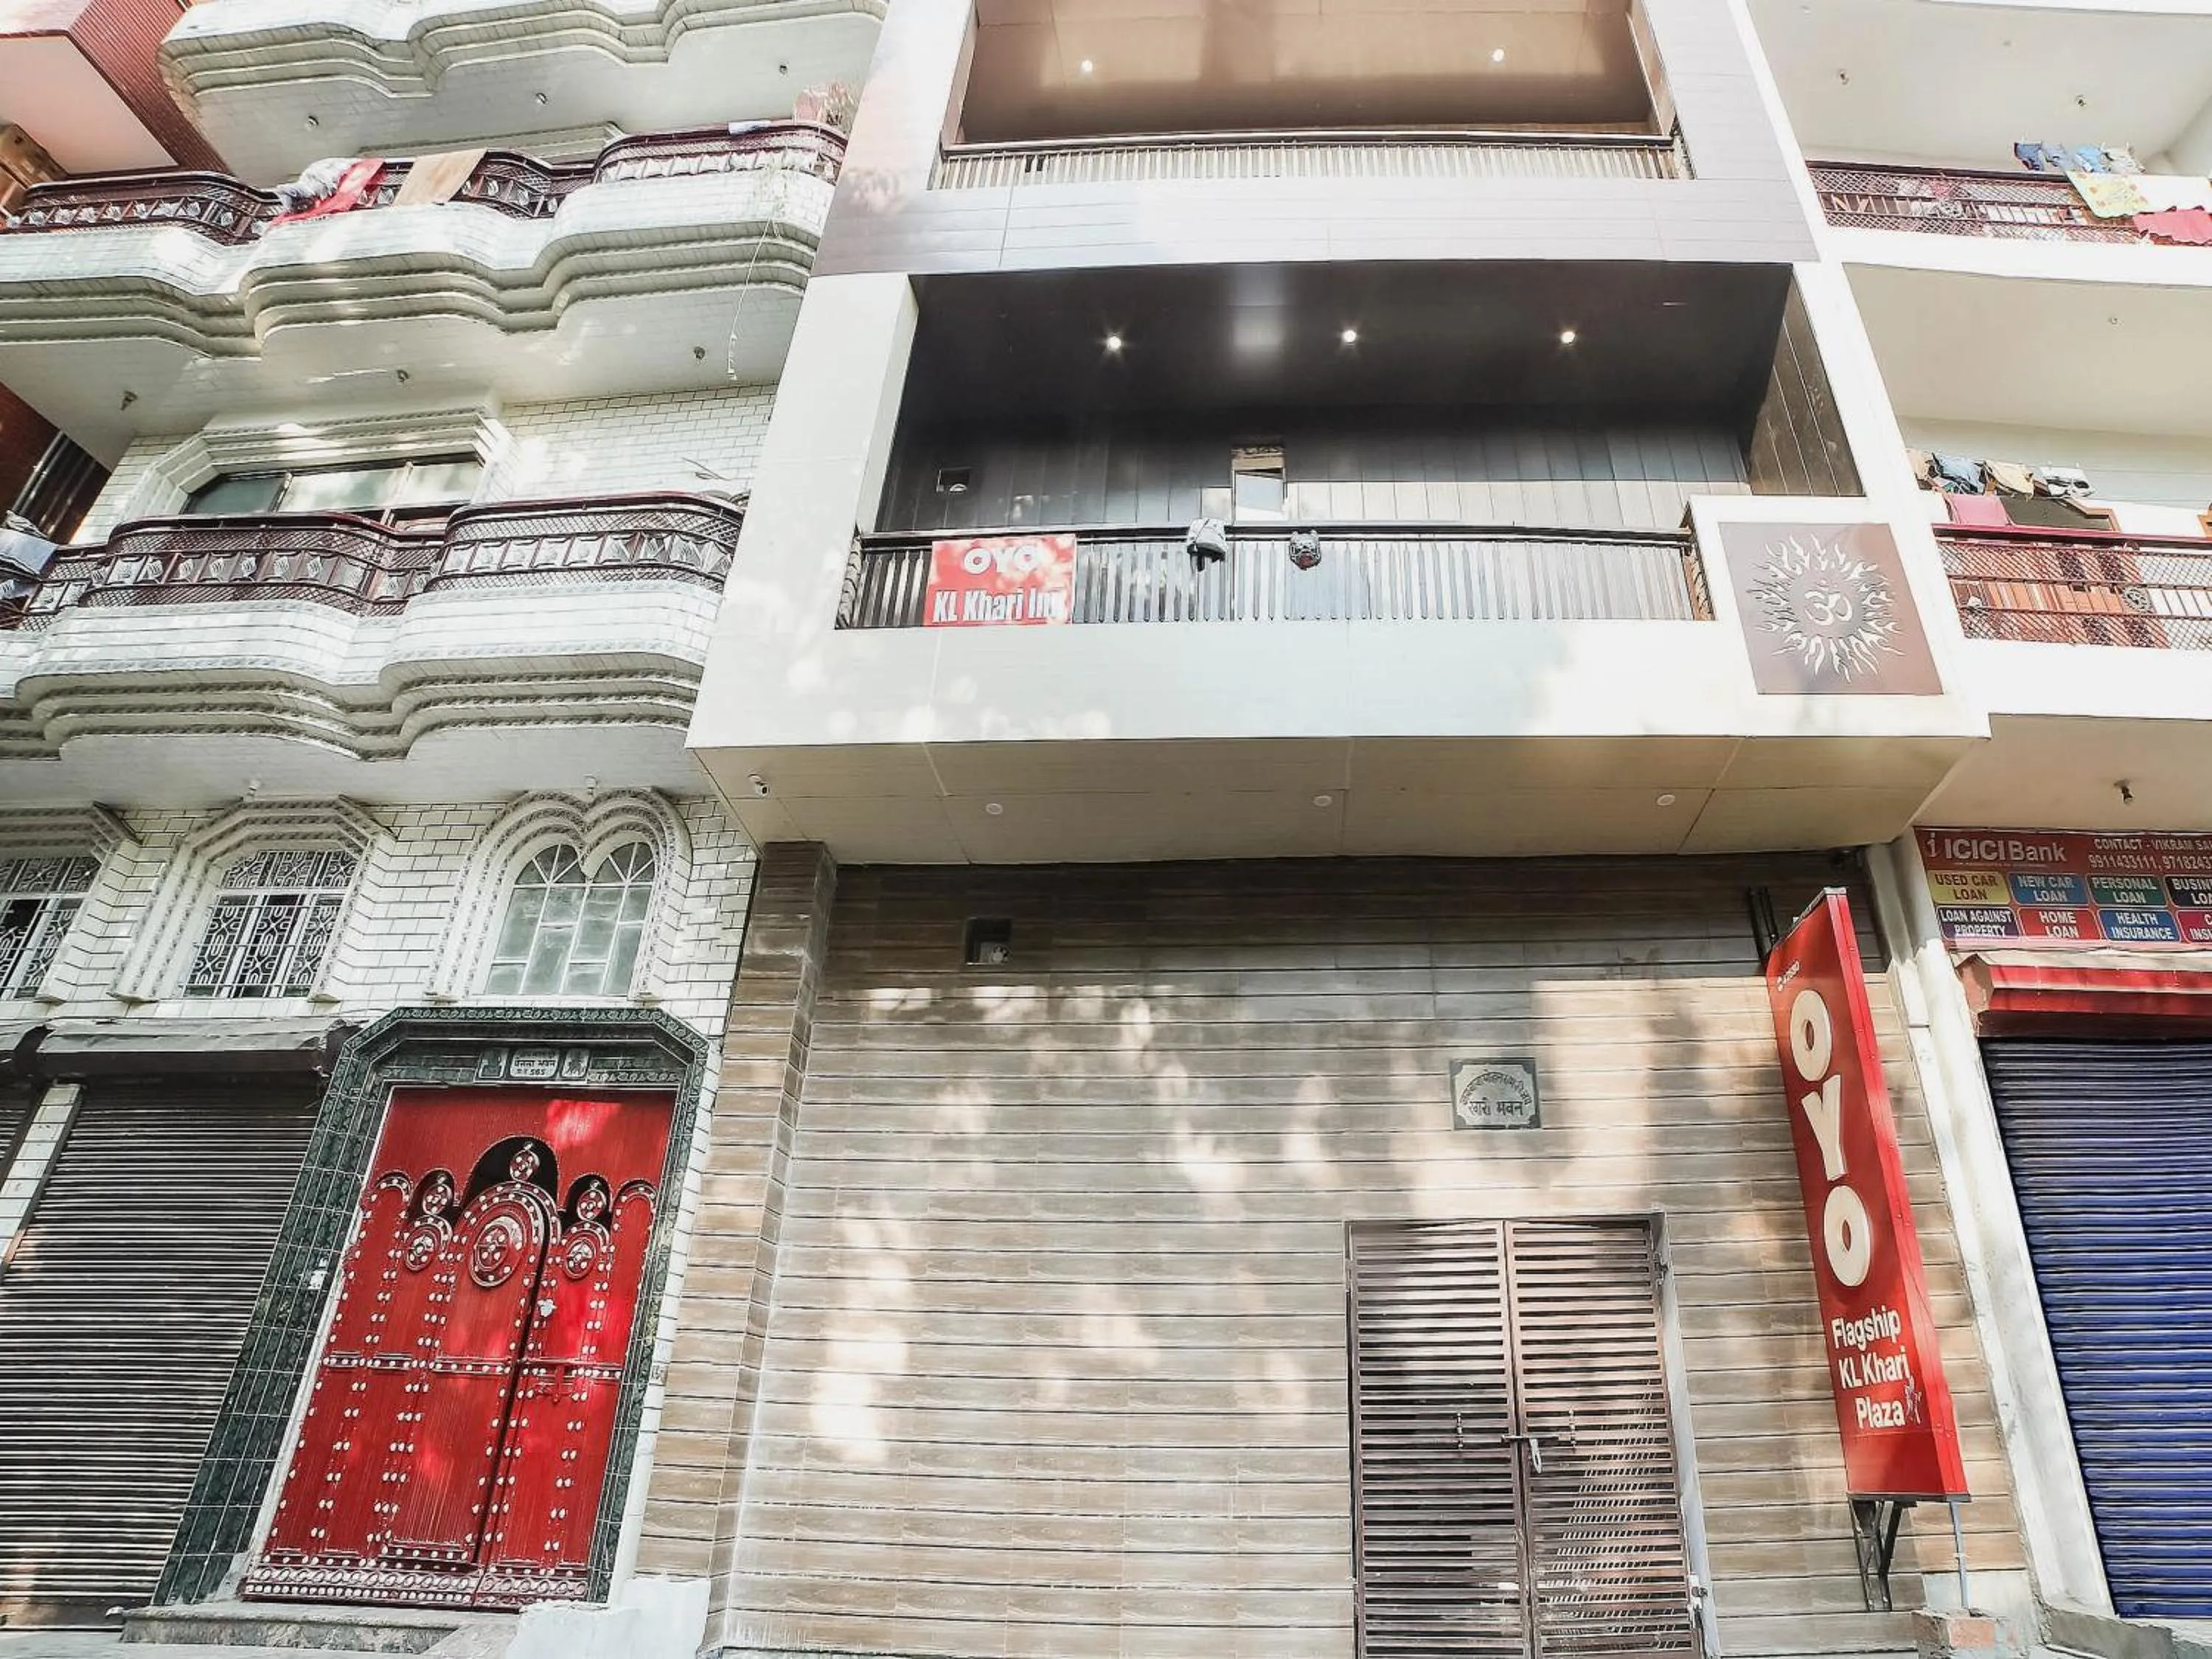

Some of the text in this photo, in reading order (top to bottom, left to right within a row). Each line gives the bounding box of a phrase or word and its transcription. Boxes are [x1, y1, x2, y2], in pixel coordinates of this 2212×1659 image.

[963, 546, 1040, 575] OYO
[932, 591, 959, 623] KL
[963, 588, 1024, 622] Khari
[2094, 838, 2143, 850] CONTACT
[2152, 839, 2195, 850] VIKRAM
[1935, 874, 1998, 887] USED CAR
[2017, 875, 2074, 889] NEW CAR
[2091, 877, 2157, 890] PERSONAL
[2171, 878, 2212, 891] BUSIN
[1954, 888, 1988, 900] LOAN
[2033, 890, 2067, 902] LOAN
[2112, 891, 2146, 903] LOAN
[1941, 909, 2012, 923] LOAN AGAINST
[2039, 911, 2077, 924] HOME
[2115, 912, 2159, 925] HEALTH
[1955, 924, 2006, 938] PROPERTY
[2045, 925, 2079, 939] LOAN
[2111, 927, 2174, 940] INSURANCE
[1496, 1101, 1523, 1116] भवन
[1790, 990, 1871, 1287] OYO
[1831, 1304, 1902, 1352] Flagship
[1838, 1345, 1910, 1389] KL Khari
[1854, 1396, 1906, 1429] Plaza
